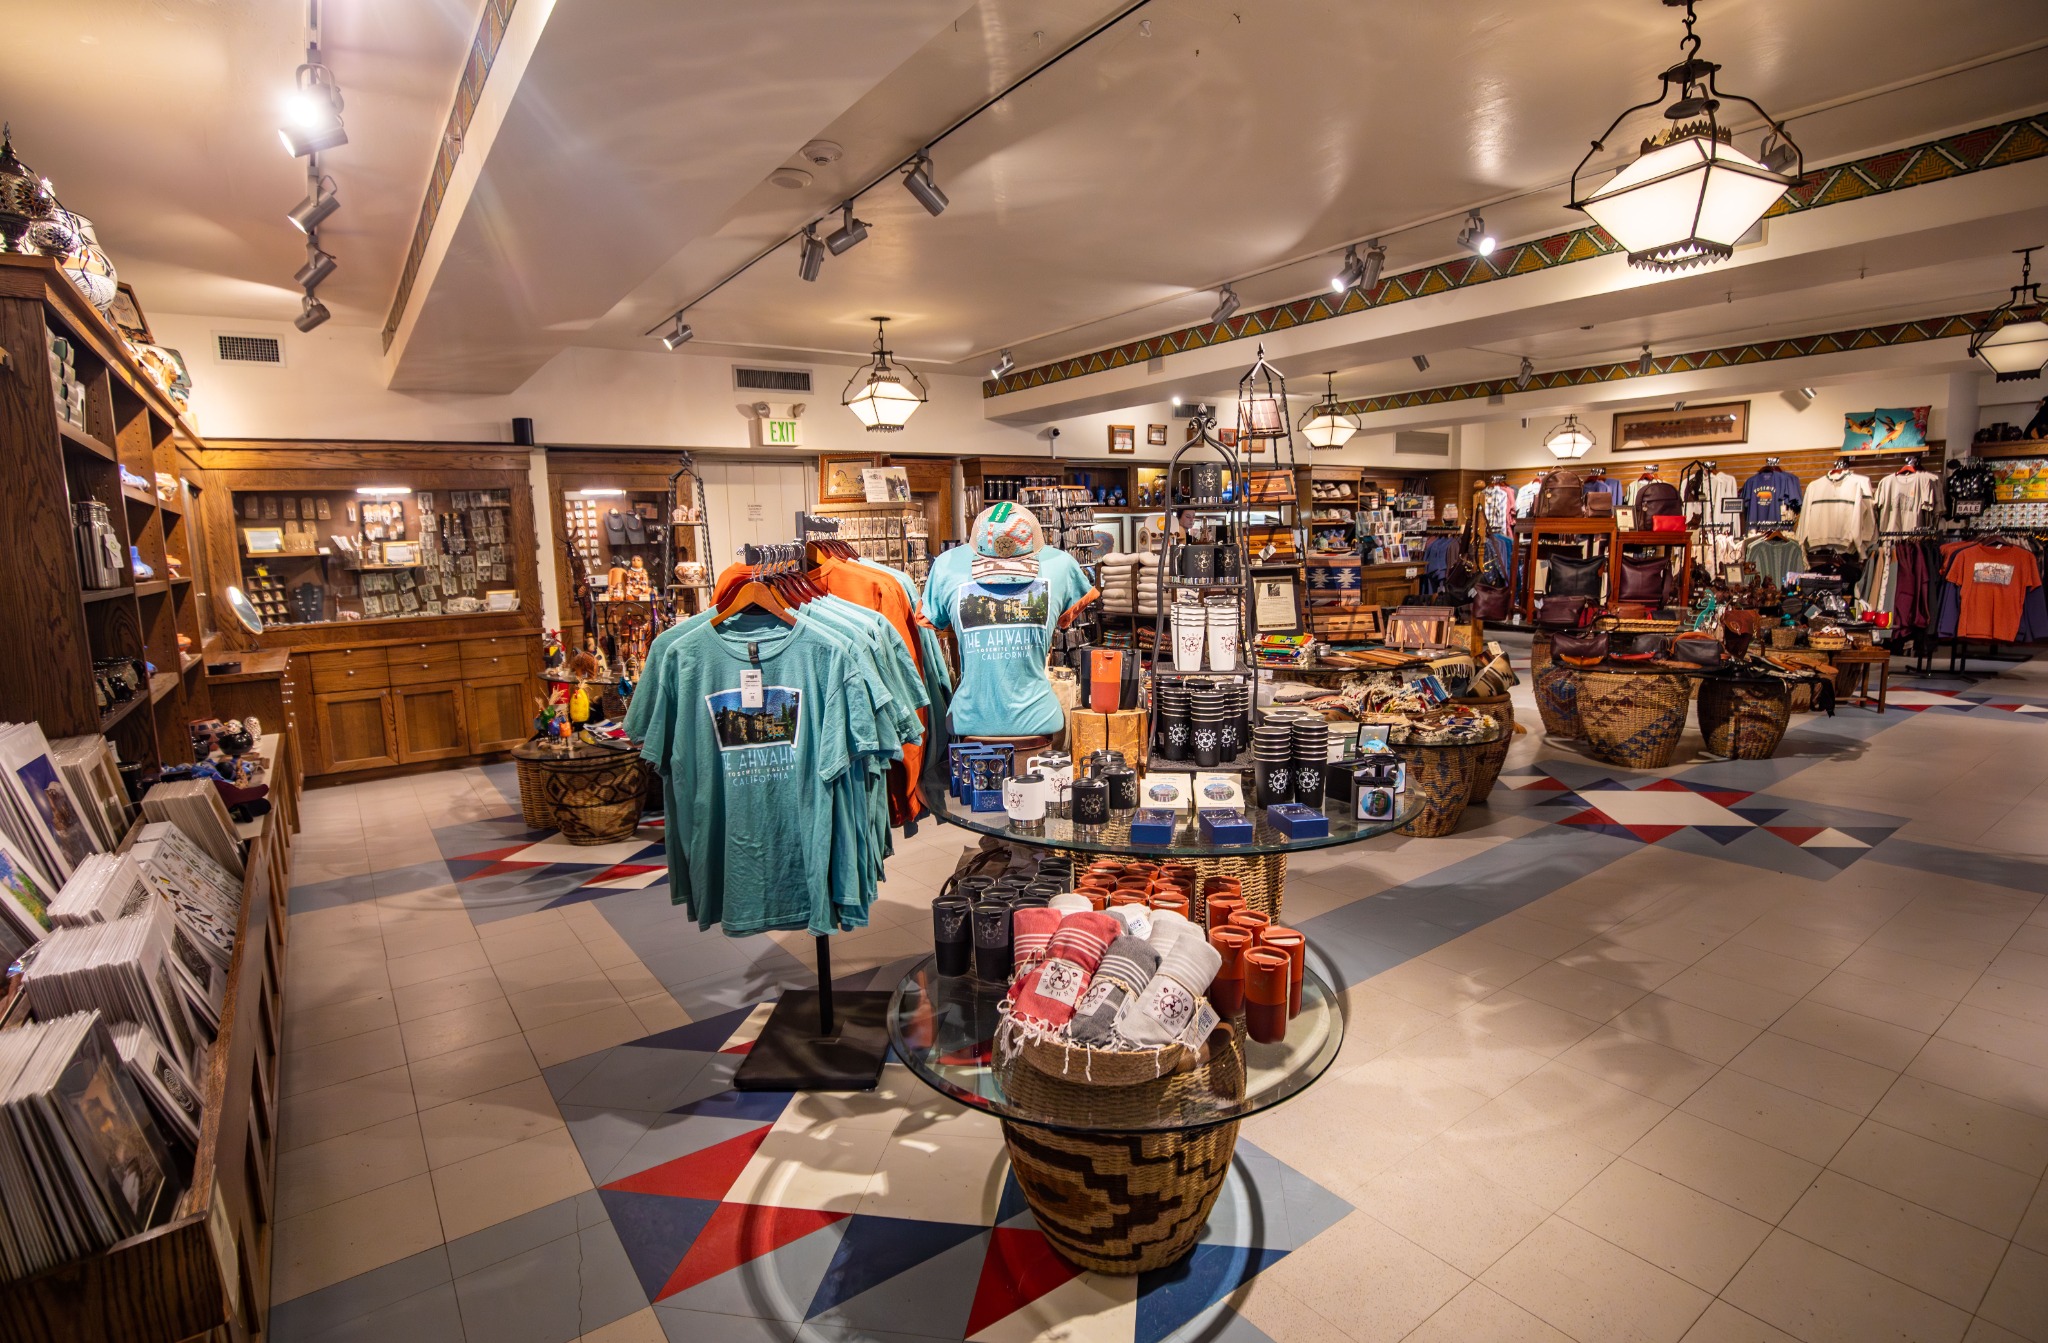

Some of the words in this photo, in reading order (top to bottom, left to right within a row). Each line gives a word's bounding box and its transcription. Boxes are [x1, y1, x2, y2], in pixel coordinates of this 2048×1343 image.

[770, 421, 796, 442] EXIT
[1957, 505, 1980, 513] SALE
[964, 632, 981, 649] THE
[981, 652, 1030, 661] CALIFORNIA
[728, 769, 761, 777] YOSEMITE
[766, 765, 794, 773] VALLEY
[733, 773, 789, 787] CALIFORNIA
